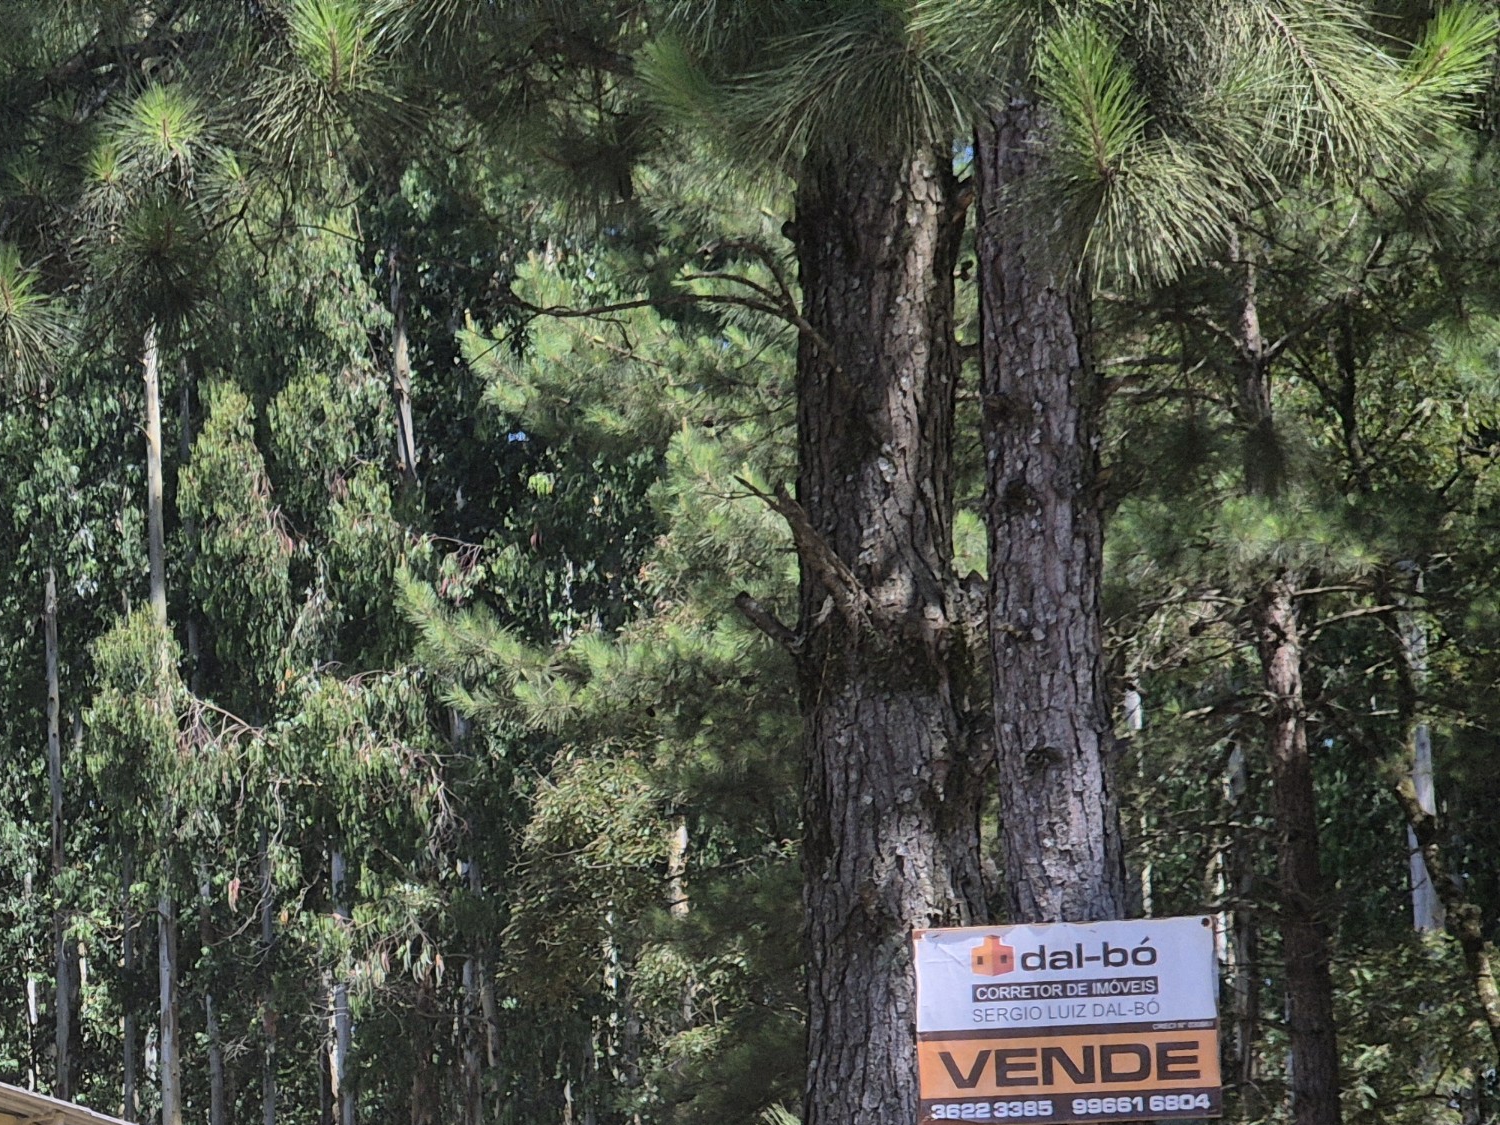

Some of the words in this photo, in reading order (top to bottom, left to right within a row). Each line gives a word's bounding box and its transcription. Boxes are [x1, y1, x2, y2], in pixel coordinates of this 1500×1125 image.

[1020, 936, 1158, 972] dal-bó
[975, 983, 1063, 1001] CORRETOR
[1065, 982, 1088, 997] DE
[1091, 978, 1156, 996] IMÓVEIS
[972, 1005, 1043, 1023] SERGIO
[1048, 1003, 1088, 1020] LUIZ
[1092, 998, 1161, 1018] DAL-BÓ
[938, 1040, 1201, 1090] VENDE
[930, 1102, 991, 1120] 3622
[993, 1100, 1054, 1118] 3385
[1071, 1096, 1144, 1116] 99661
[1149, 1093, 1211, 1112] 6804
